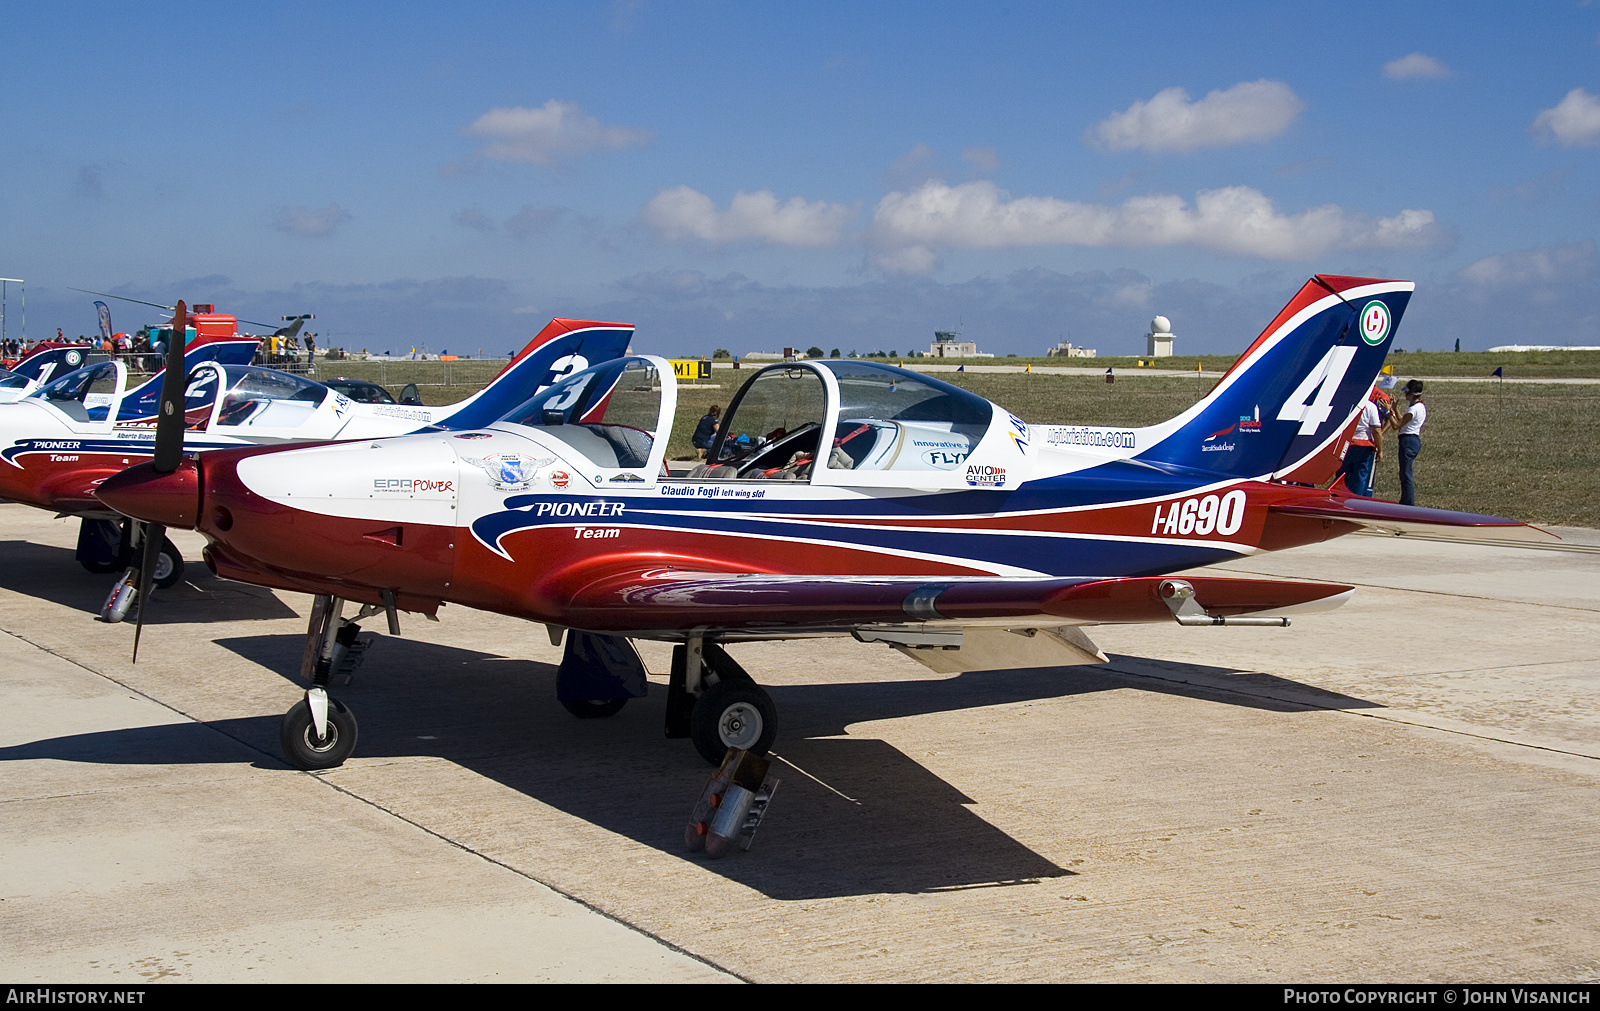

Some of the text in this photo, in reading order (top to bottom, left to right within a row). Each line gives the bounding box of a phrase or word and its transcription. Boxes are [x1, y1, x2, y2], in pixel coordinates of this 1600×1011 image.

[39, 362, 58, 386] 1
[674, 362, 709, 377] M1 L
[184, 366, 218, 398] 2
[533, 354, 597, 411] 3
[1276, 344, 1358, 435] 4
[33, 441, 80, 449] PIONEER
[913, 439, 962, 449] innovative
[1047, 427, 1136, 448] AlpiAviation.com
[966, 465, 992, 475] AVIO
[966, 474, 1006, 482] CENTER
[661, 485, 766, 498] Claudio Fogli left wing slot
[535, 502, 626, 517] PIONEER
[1151, 489, 1247, 536] I-A690
[573, 527, 620, 539] Team
